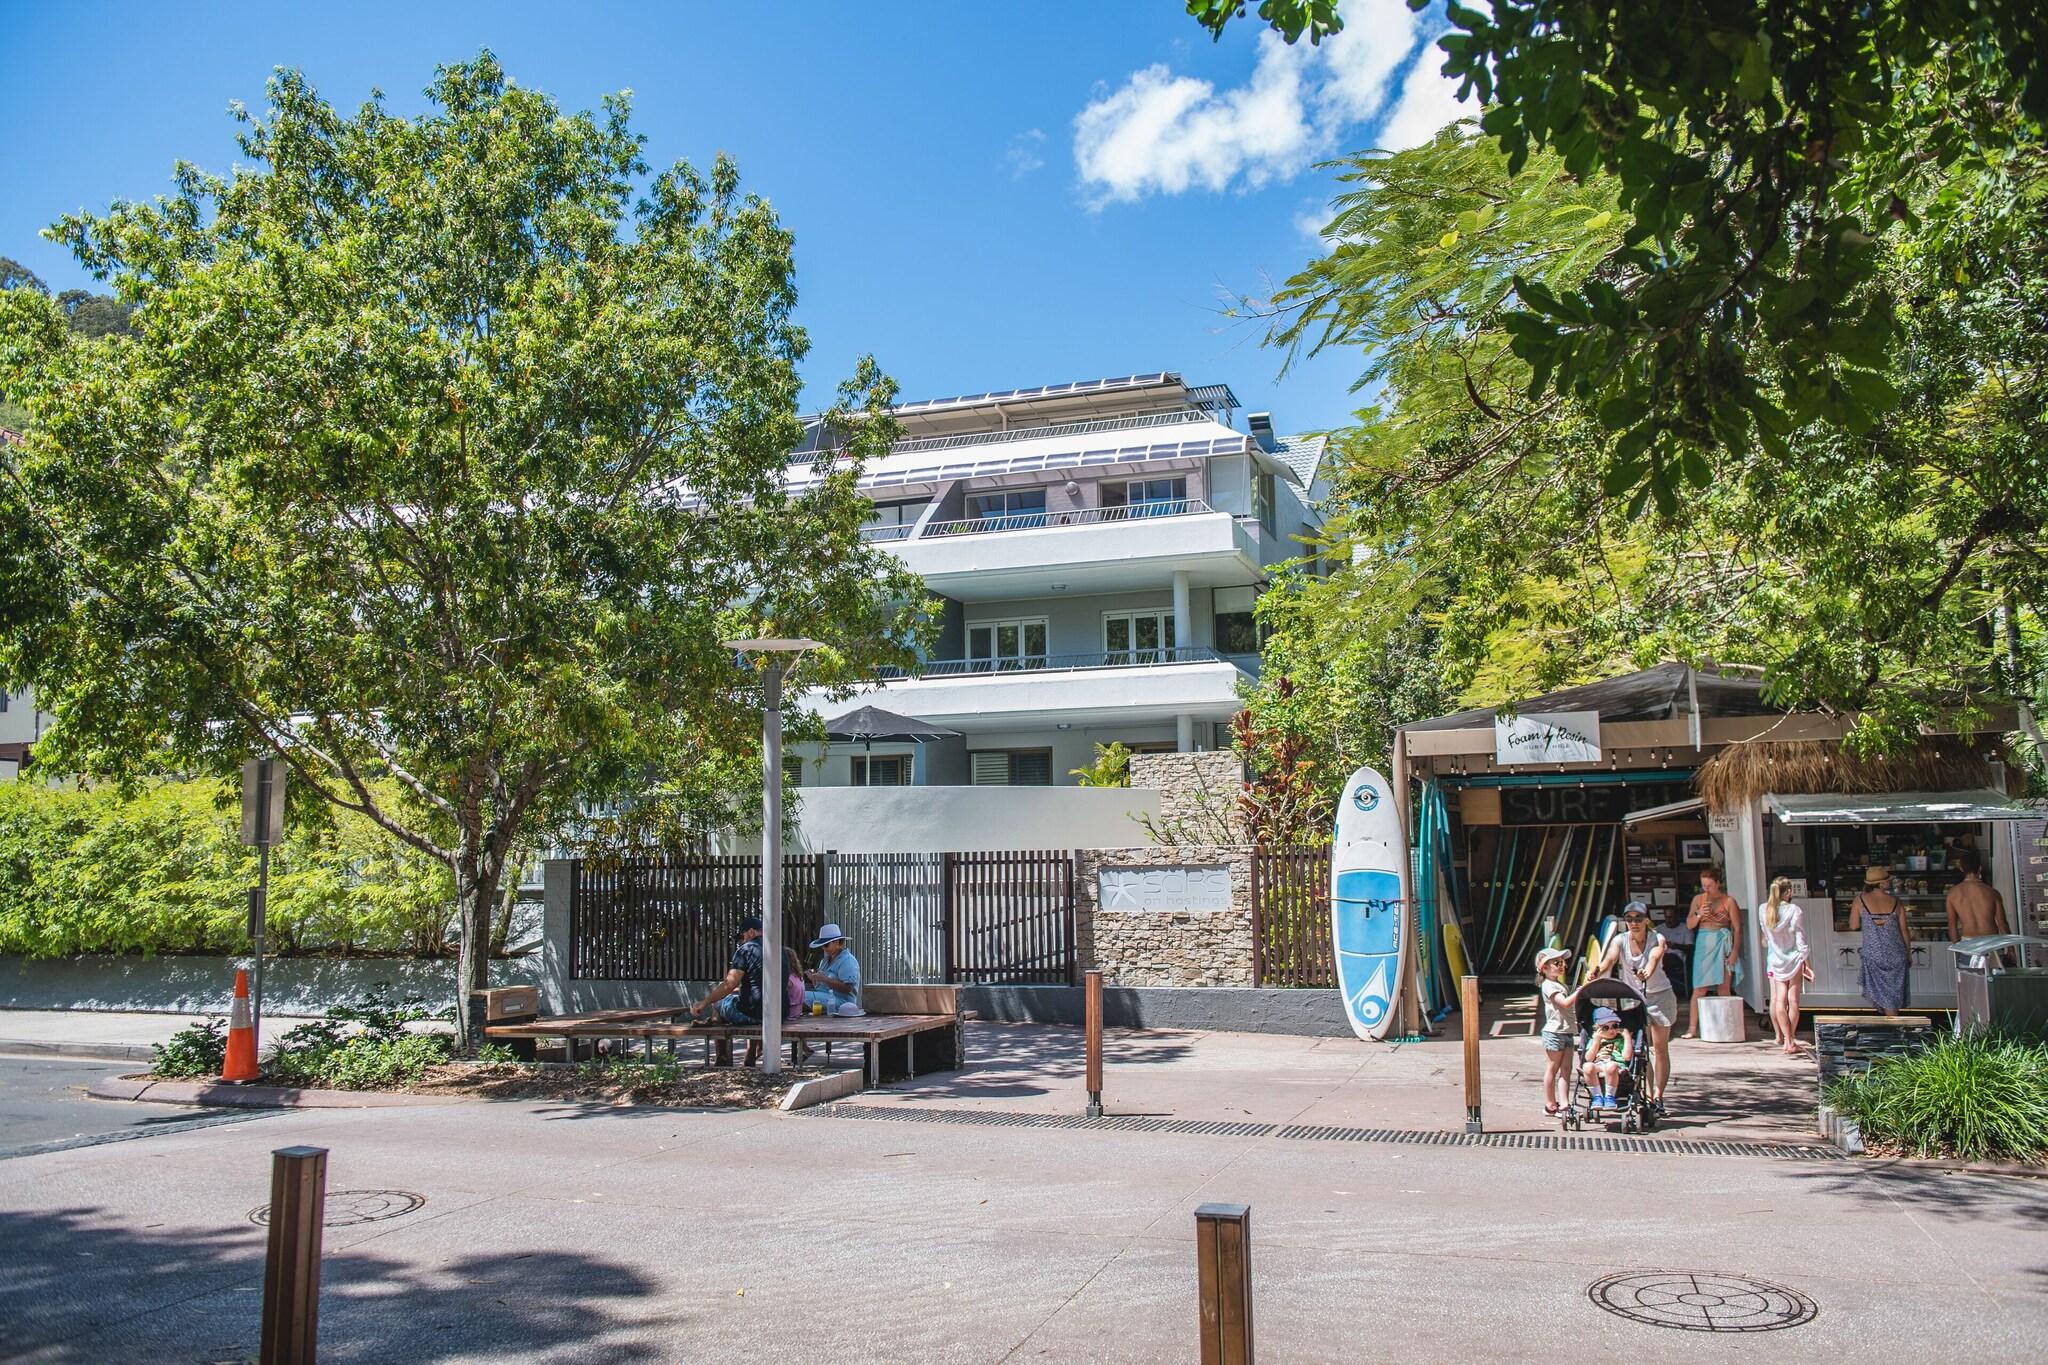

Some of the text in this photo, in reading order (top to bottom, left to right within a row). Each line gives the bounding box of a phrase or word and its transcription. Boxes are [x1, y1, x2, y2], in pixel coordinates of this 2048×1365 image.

[1507, 726, 1588, 749] Foam Resin
[1507, 788, 1611, 821] SURF
